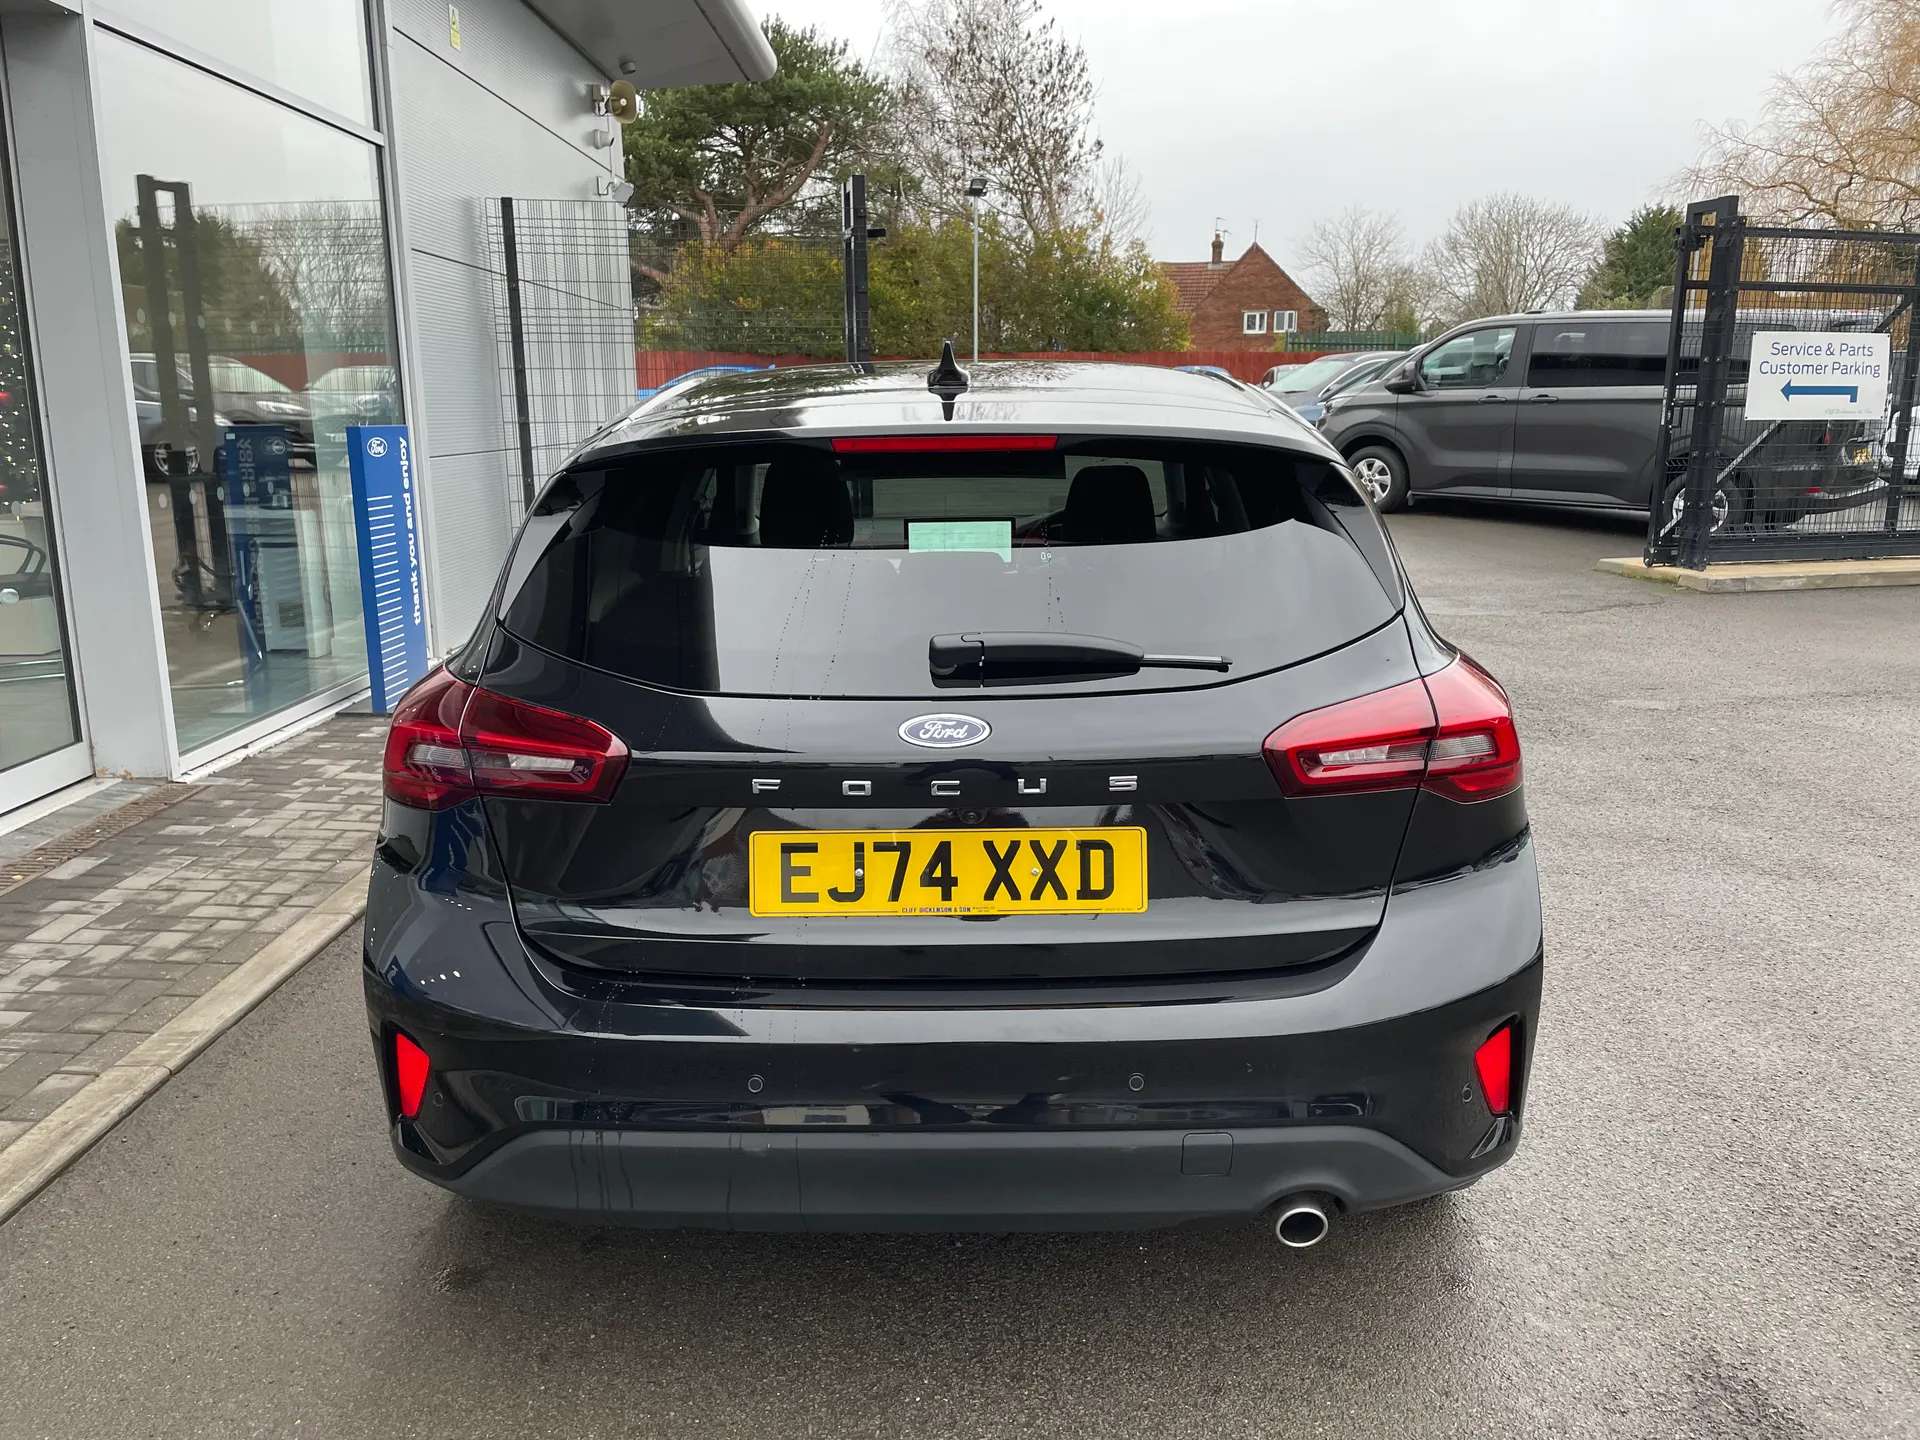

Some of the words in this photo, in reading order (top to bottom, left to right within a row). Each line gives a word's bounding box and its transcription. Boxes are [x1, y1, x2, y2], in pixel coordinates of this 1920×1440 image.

[1770, 342, 1822, 356] Service
[1825, 342, 1835, 356] &
[1840, 343, 1873, 357] Parts
[1760, 360, 1828, 375] Customer
[1832, 361, 1880, 378] Parking
[400, 436, 410, 489] enjoy
[403, 492, 413, 529] and
[408, 533, 418, 569] you
[410, 570, 421, 626] thank
[919, 720, 969, 739] Ford
[780, 840, 959, 903] EJ74
[982, 839, 1115, 902] XXD
